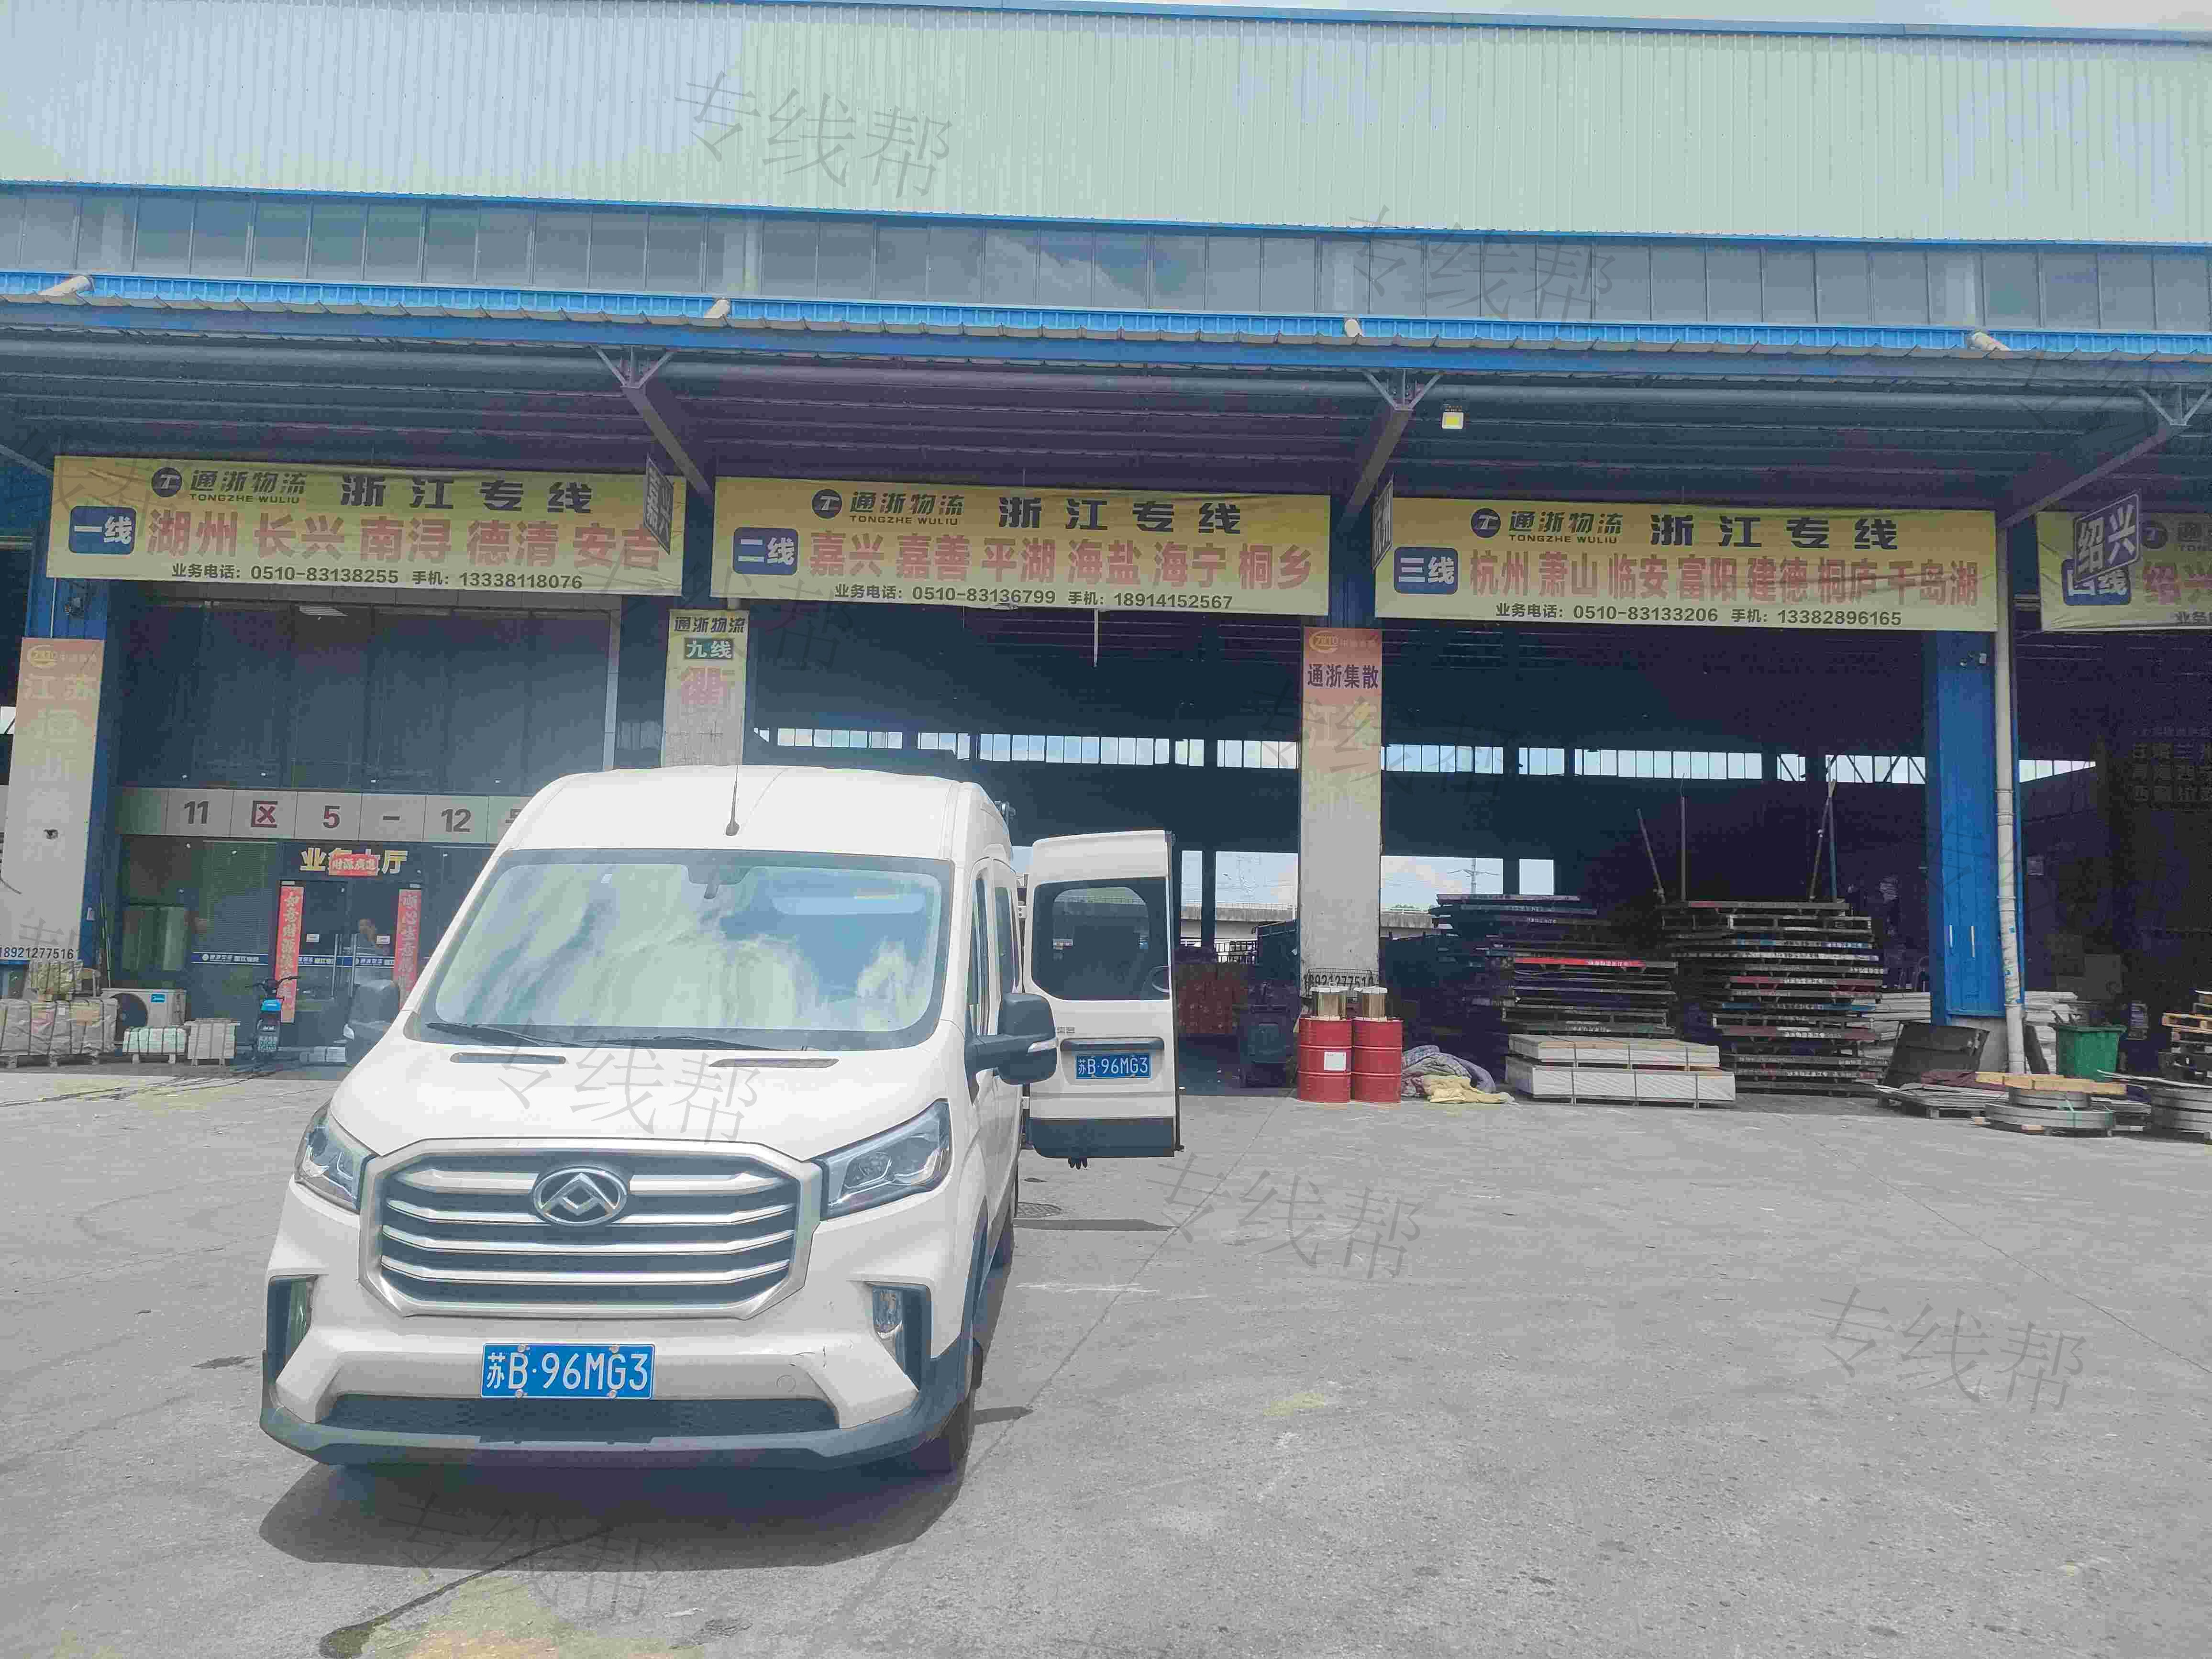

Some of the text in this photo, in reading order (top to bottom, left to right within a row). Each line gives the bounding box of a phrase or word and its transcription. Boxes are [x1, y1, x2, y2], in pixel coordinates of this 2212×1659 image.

[189, 469, 308, 495] 通浙物流
[340, 476, 593, 513] 浙江专线
[189, 493, 300, 504] TONGZHE WULIU
[849, 490, 965, 516] 通浙物流
[850, 515, 958, 526] TONGZHE WULIU
[998, 497, 1241, 535] 浙江专线
[1509, 510, 1624, 535] 通浙物流
[73, 515, 133, 545] 一线
[146, 509, 662, 571] 湖州 长兴 南浔 德清 安吉
[1509, 534, 1618, 544] TONGZHE WULIU
[1650, 514, 1898, 550] 浙江专线
[2078, 503, 2136, 573] 绍兴
[737, 536, 796, 566] 二线
[809, 530, 1312, 590] 嘉兴 嘉善 平湖 海盐 海宁 桐乡
[1397, 555, 1455, 586] 三线
[674, 616, 746, 633] 通浙物流
[686, 640, 732, 659] 九线
[1307, 663, 1379, 689] 通浙集散
[299, 847, 409, 874] 业厅
[1078, 1057, 1149, 1075] 苏B·96MG3
[486, 1351, 649, 1391] 苏B·96MG3
